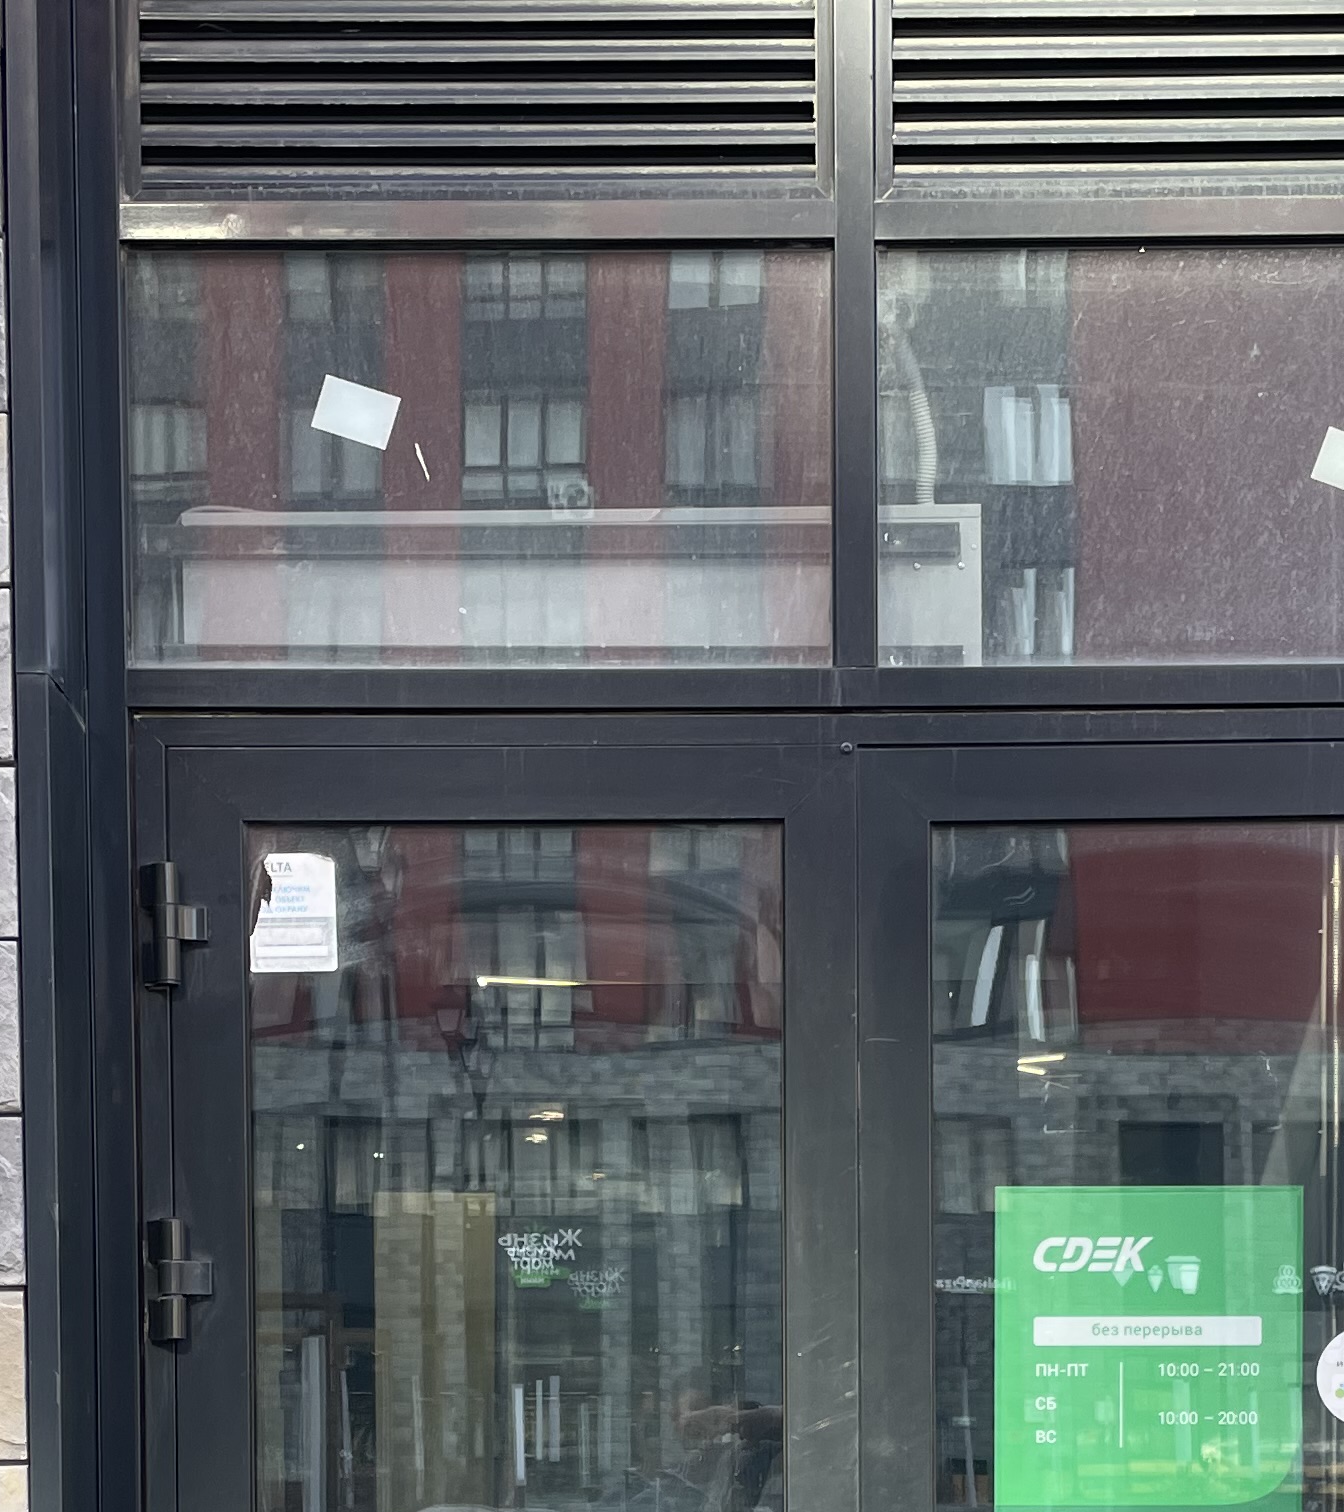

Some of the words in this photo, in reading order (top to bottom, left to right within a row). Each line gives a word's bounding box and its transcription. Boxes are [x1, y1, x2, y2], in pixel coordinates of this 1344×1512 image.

[1032, 1236, 1154, 1272] CDEK
[1091, 1323, 1119, 1336] без
[1123, 1325, 1203, 1338] перерыва
[1035, 1363, 1089, 1377] ПН-ПТ
[1158, 1362, 1200, 1377] 10:00
[1217, 1362, 1260, 1377] 21:00
[1034, 1396, 1057, 1411] СБ
[1158, 1411, 1198, 1425] 10:00
[1217, 1411, 1258, 1425] 20:00
[1035, 1430, 1057, 1444] ВС
